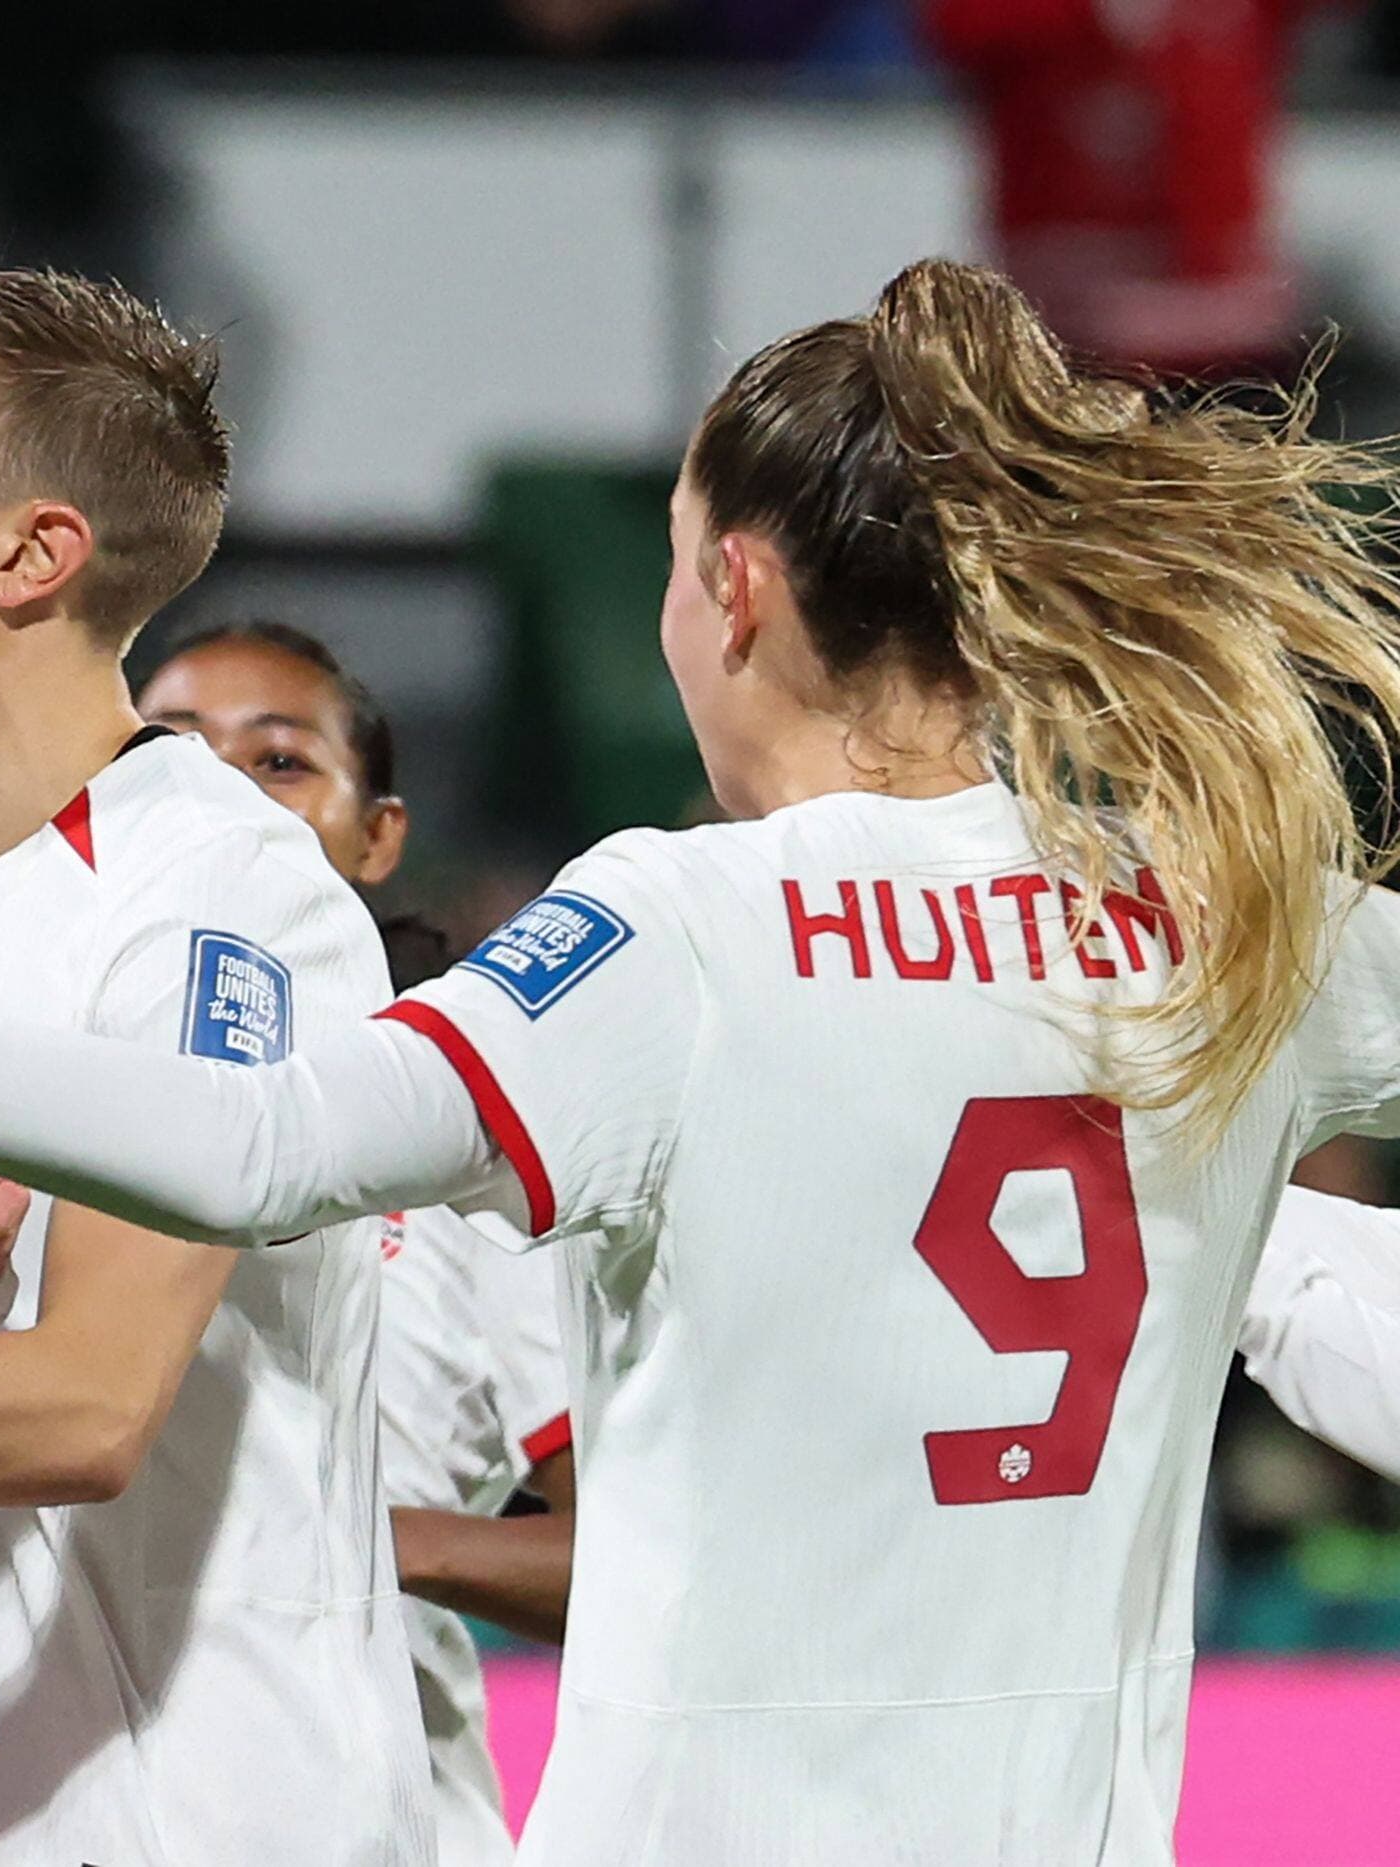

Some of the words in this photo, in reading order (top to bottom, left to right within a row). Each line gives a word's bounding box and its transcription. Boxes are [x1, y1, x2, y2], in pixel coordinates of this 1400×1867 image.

[781, 866, 1208, 983] HUITEM
[216, 973, 277, 1021] UNITES
[218, 954, 277, 996] FOOTBALL
[208, 999, 238, 1021] the
[912, 1093, 1148, 1505] 9
